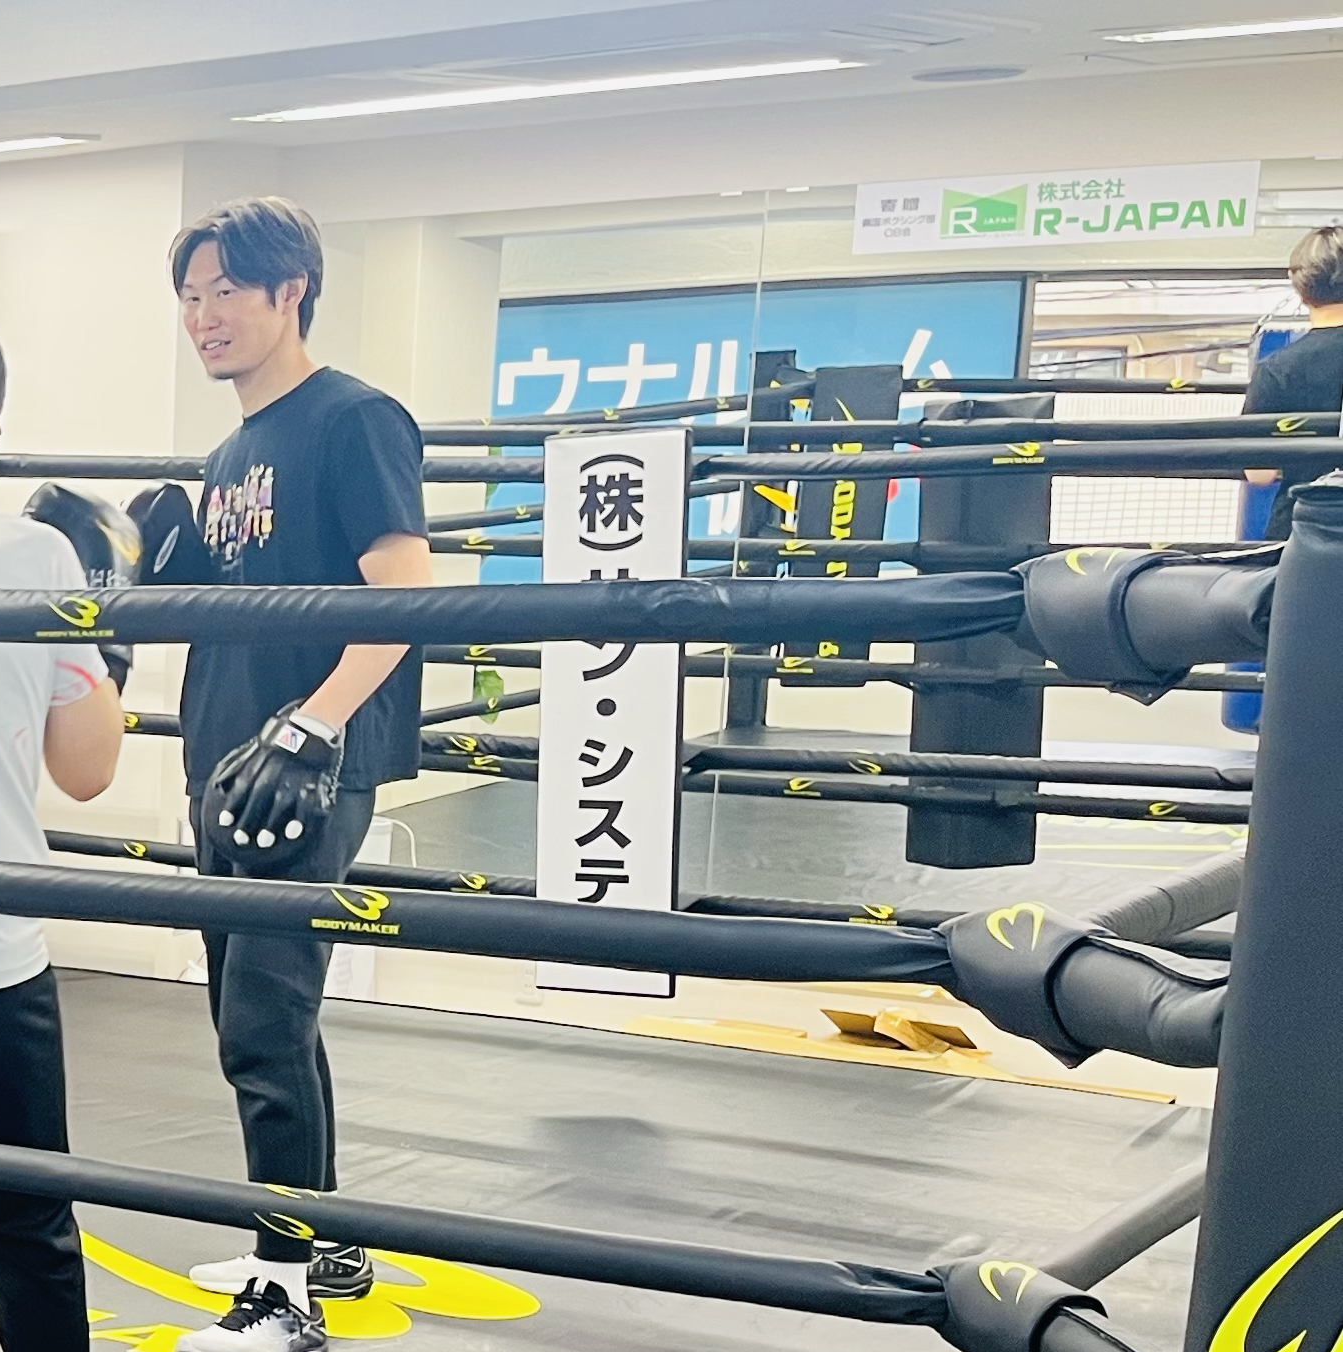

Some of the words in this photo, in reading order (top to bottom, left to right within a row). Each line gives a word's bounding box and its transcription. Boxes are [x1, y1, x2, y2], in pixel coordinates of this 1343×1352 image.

[1037, 178, 1125, 202] 株式会社
[1033, 198, 1247, 236] R-JAPAN
[311, 918, 401, 936] BODYMAKER
